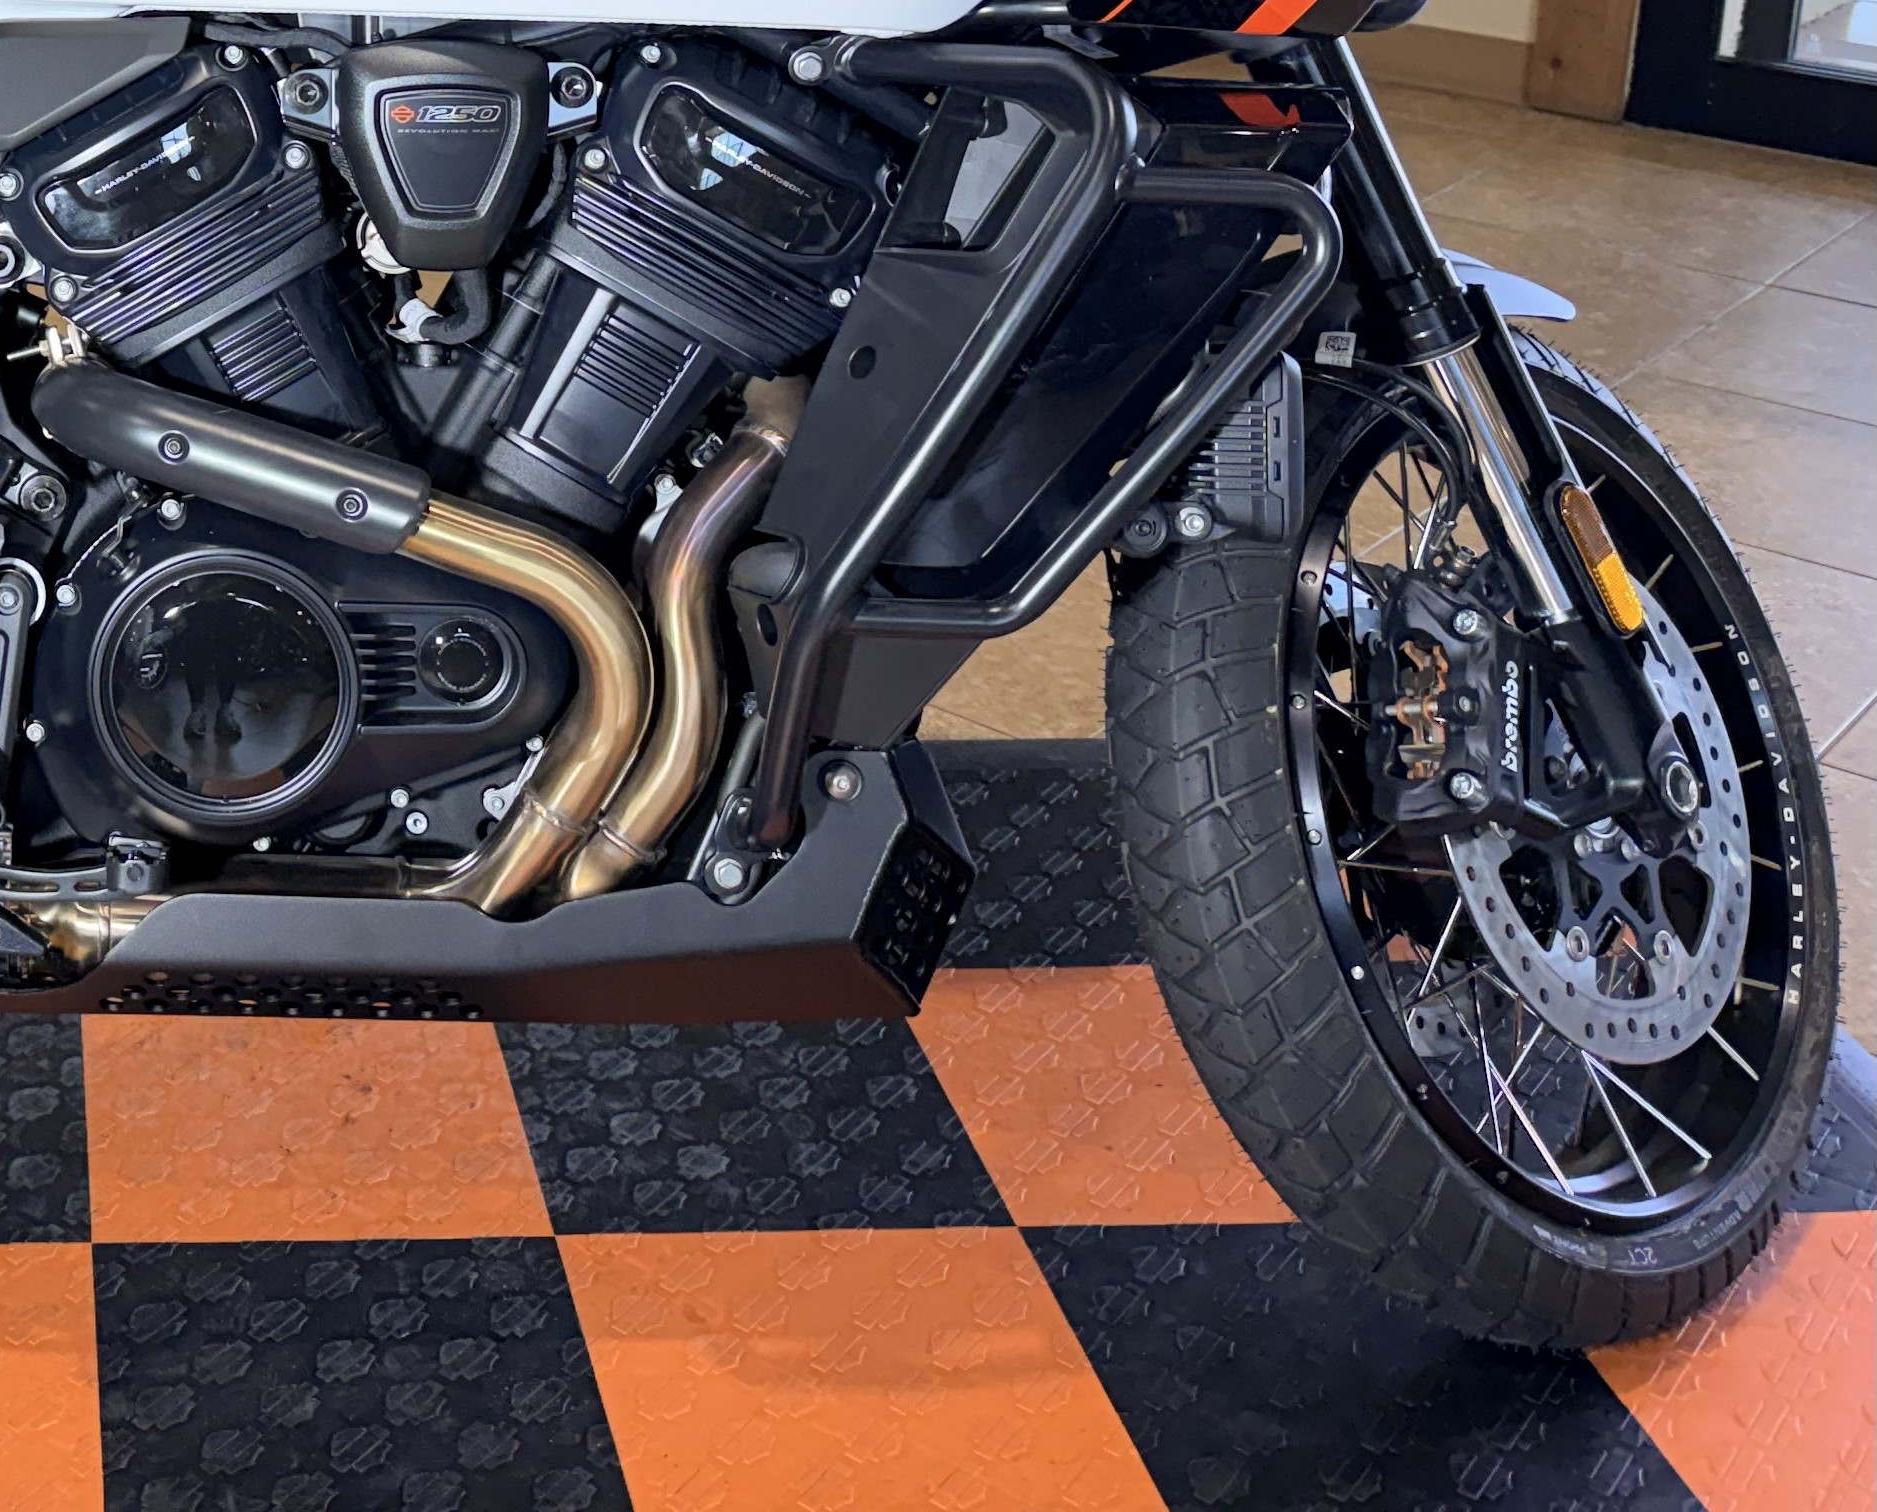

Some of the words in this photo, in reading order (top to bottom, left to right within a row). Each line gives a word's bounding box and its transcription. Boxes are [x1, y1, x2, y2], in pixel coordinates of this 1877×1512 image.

[415, 105, 502, 123] 1250
[101, 138, 190, 192] HARLEY-DAVI
[1500, 659, 1519, 773] brembo
[1724, 624, 1805, 1005] HARLEY-DAVIDSON
[1627, 1246, 1658, 1266] 2CT
